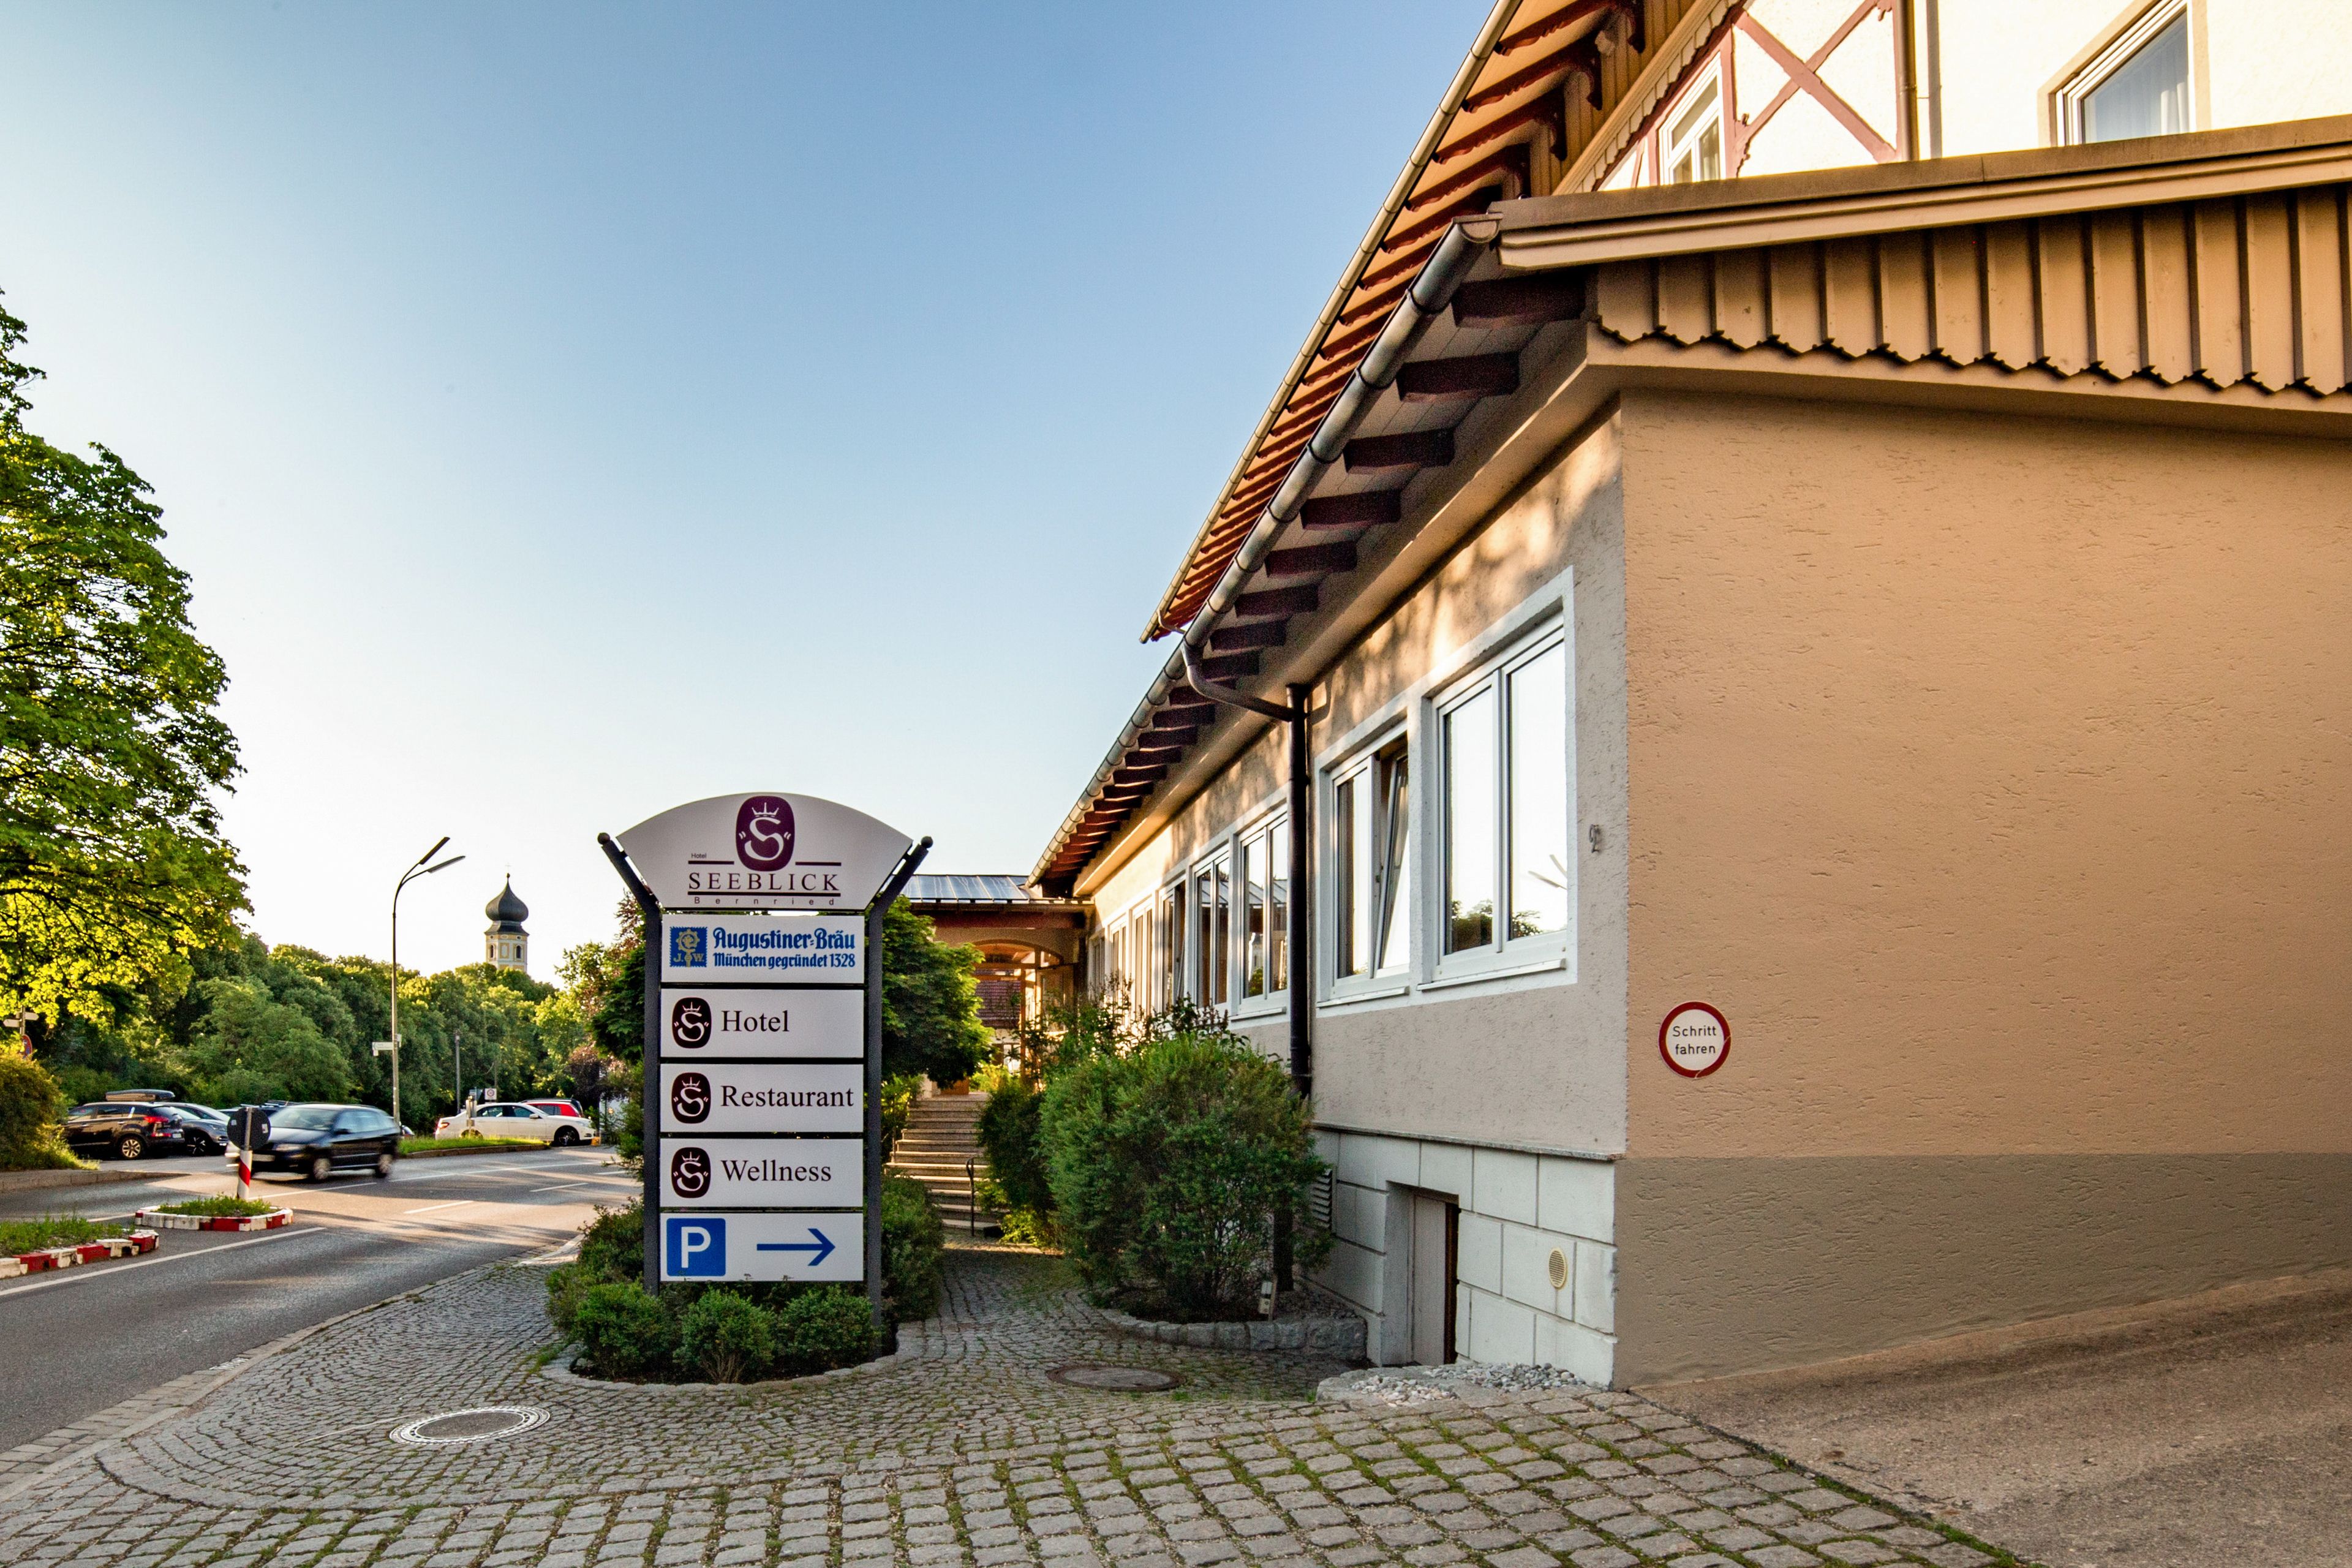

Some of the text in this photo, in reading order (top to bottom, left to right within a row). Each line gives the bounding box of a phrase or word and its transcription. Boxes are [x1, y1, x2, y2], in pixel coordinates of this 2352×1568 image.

[688, 872, 840, 891] SEEBLICK
[694, 897, 834, 906] Bernried
[713, 952, 856, 970] München gegründet 1328
[721, 1010, 790, 1033] Hotel
[1672, 1025, 1717, 1037] Schritt
[1675, 1044, 1716, 1055] fahren
[721, 1085, 854, 1107] Restaurant
[721, 1159, 832, 1182] Wellness
